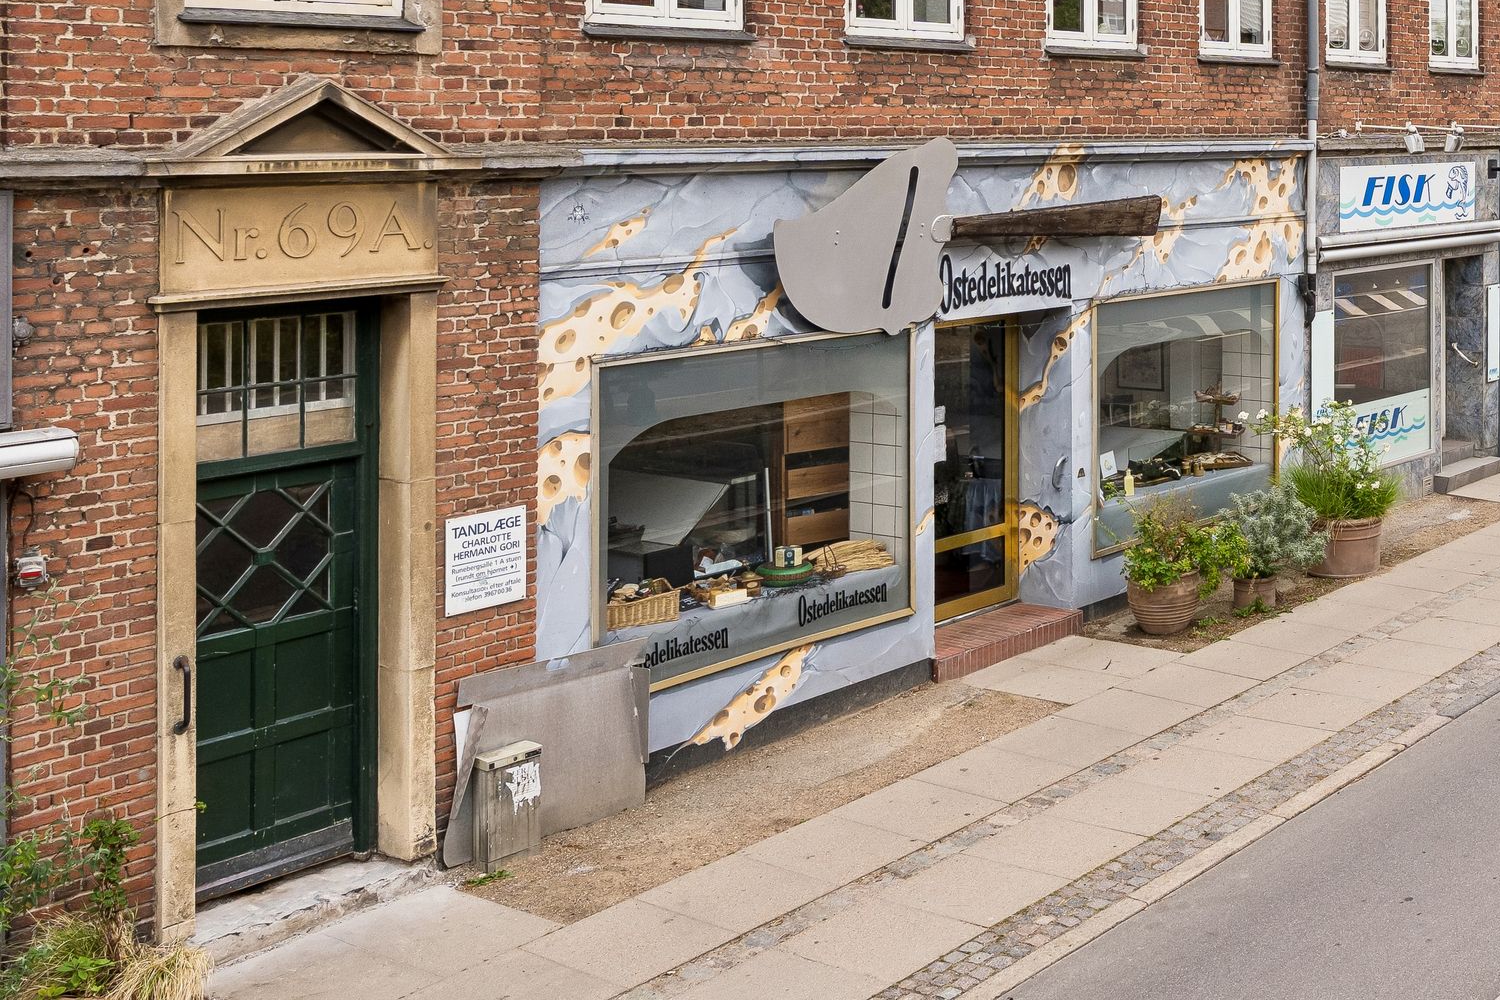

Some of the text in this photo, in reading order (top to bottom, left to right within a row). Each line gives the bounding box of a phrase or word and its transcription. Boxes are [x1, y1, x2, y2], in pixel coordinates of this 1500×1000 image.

[1362, 173, 1436, 206] FISK
[939, 253, 1073, 315] Ostedelikatessen
[451, 515, 521, 539] TANDLÆGE
[461, 531, 512, 549] CHARLOTTE
[453, 540, 520, 561] HERMANN GORI
[798, 582, 888, 628] Ostedelikatessen
